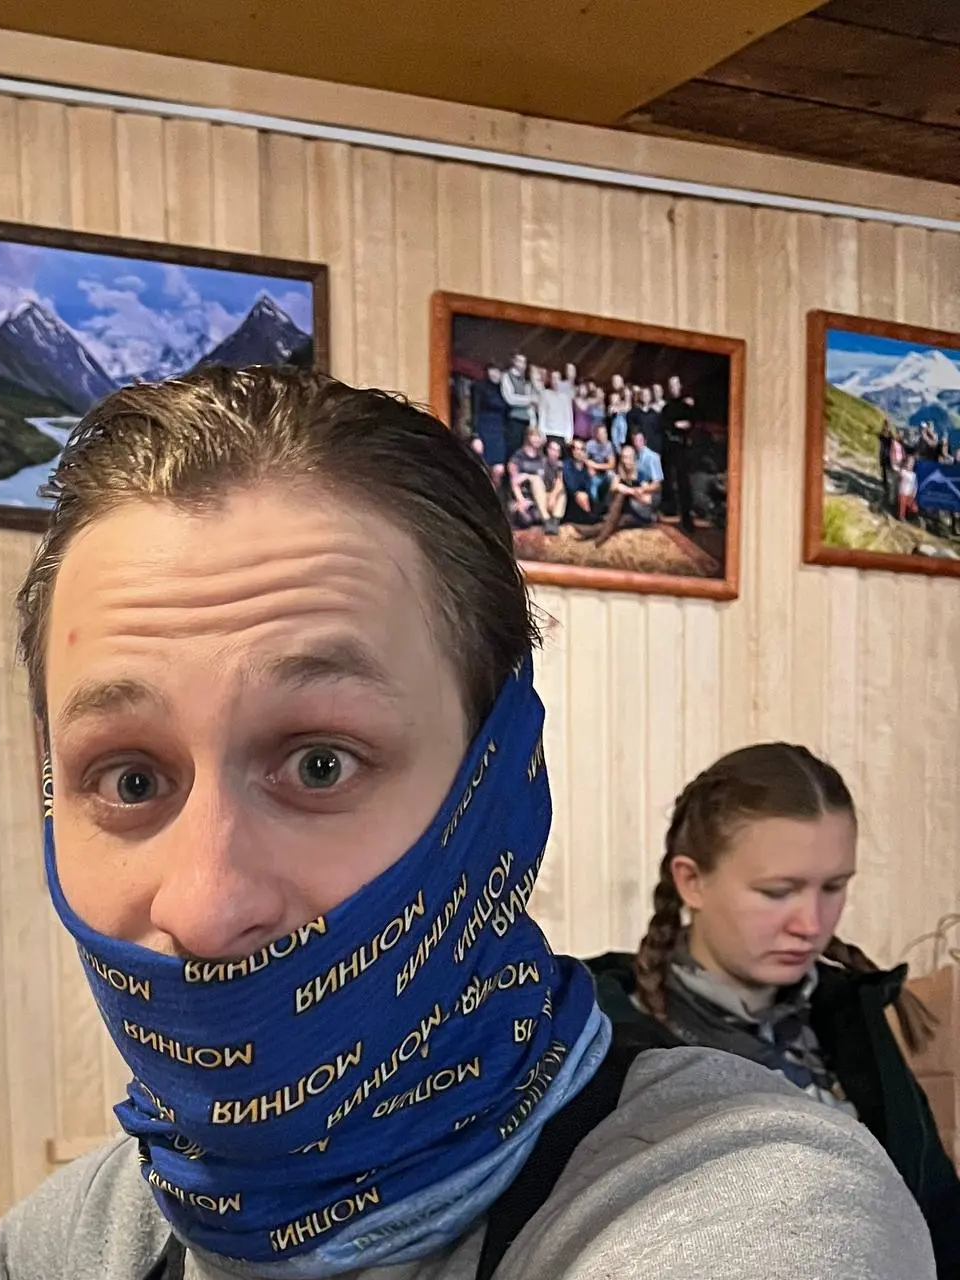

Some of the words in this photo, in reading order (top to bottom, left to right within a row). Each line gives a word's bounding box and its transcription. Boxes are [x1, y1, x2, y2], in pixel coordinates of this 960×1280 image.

[184, 915, 328, 983] МОЛНИЯ
[295, 889, 426, 1015] МОЛНИЯ
[122, 1018, 254, 1069] МОЛНИЯ
[212, 1040, 363, 1125] МОЛНИЯ
[327, 1003, 442, 1130] МОЛНИЯ
